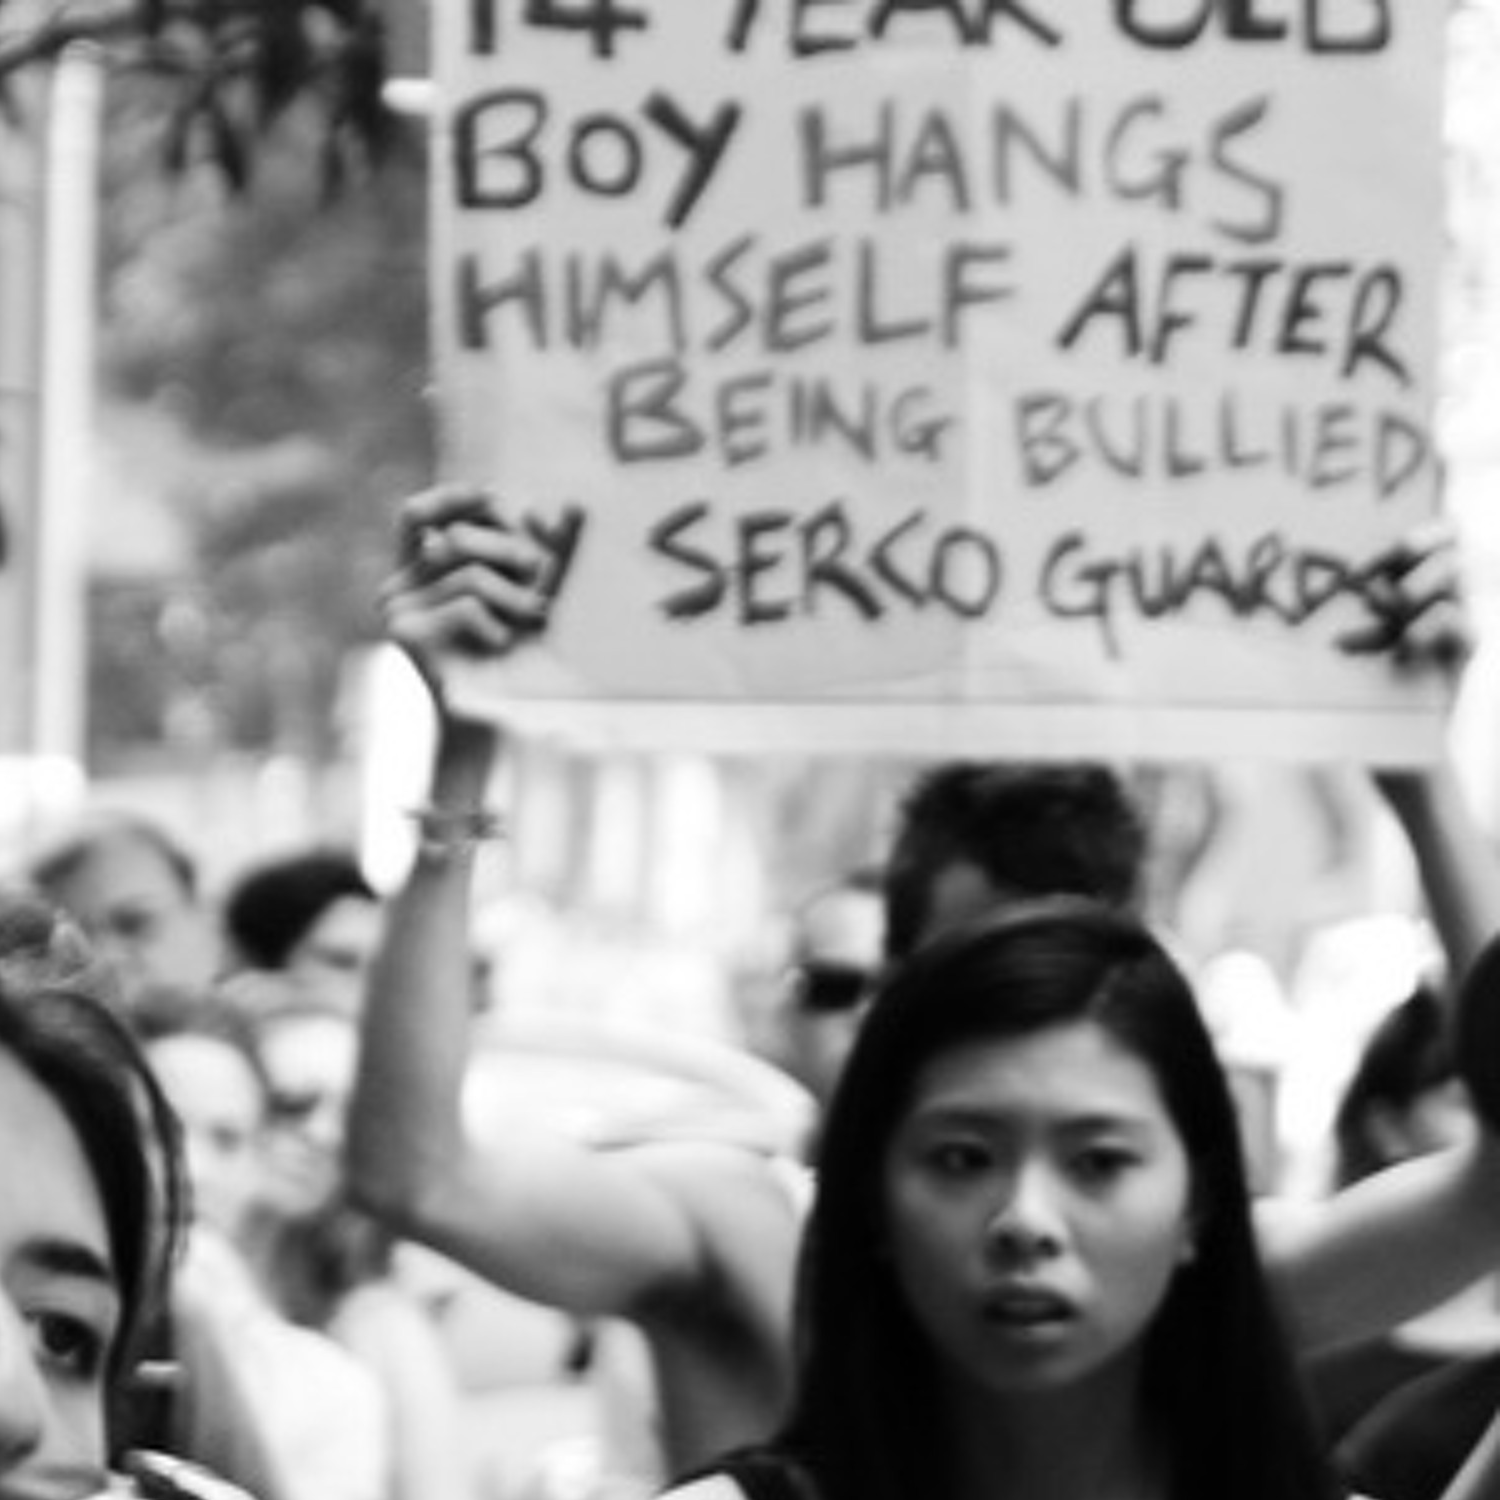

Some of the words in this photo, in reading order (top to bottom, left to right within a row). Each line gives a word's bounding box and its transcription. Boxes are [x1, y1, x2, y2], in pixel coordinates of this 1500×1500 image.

[449, 87, 745, 230] BOY
[799, 92, 1290, 245] HANGS
[453, 236, 1015, 353] HIMSELF
[1057, 244, 1410, 385] AFTER
[605, 358, 955, 468] BEING
[645, 500, 1004, 628] SERCO
